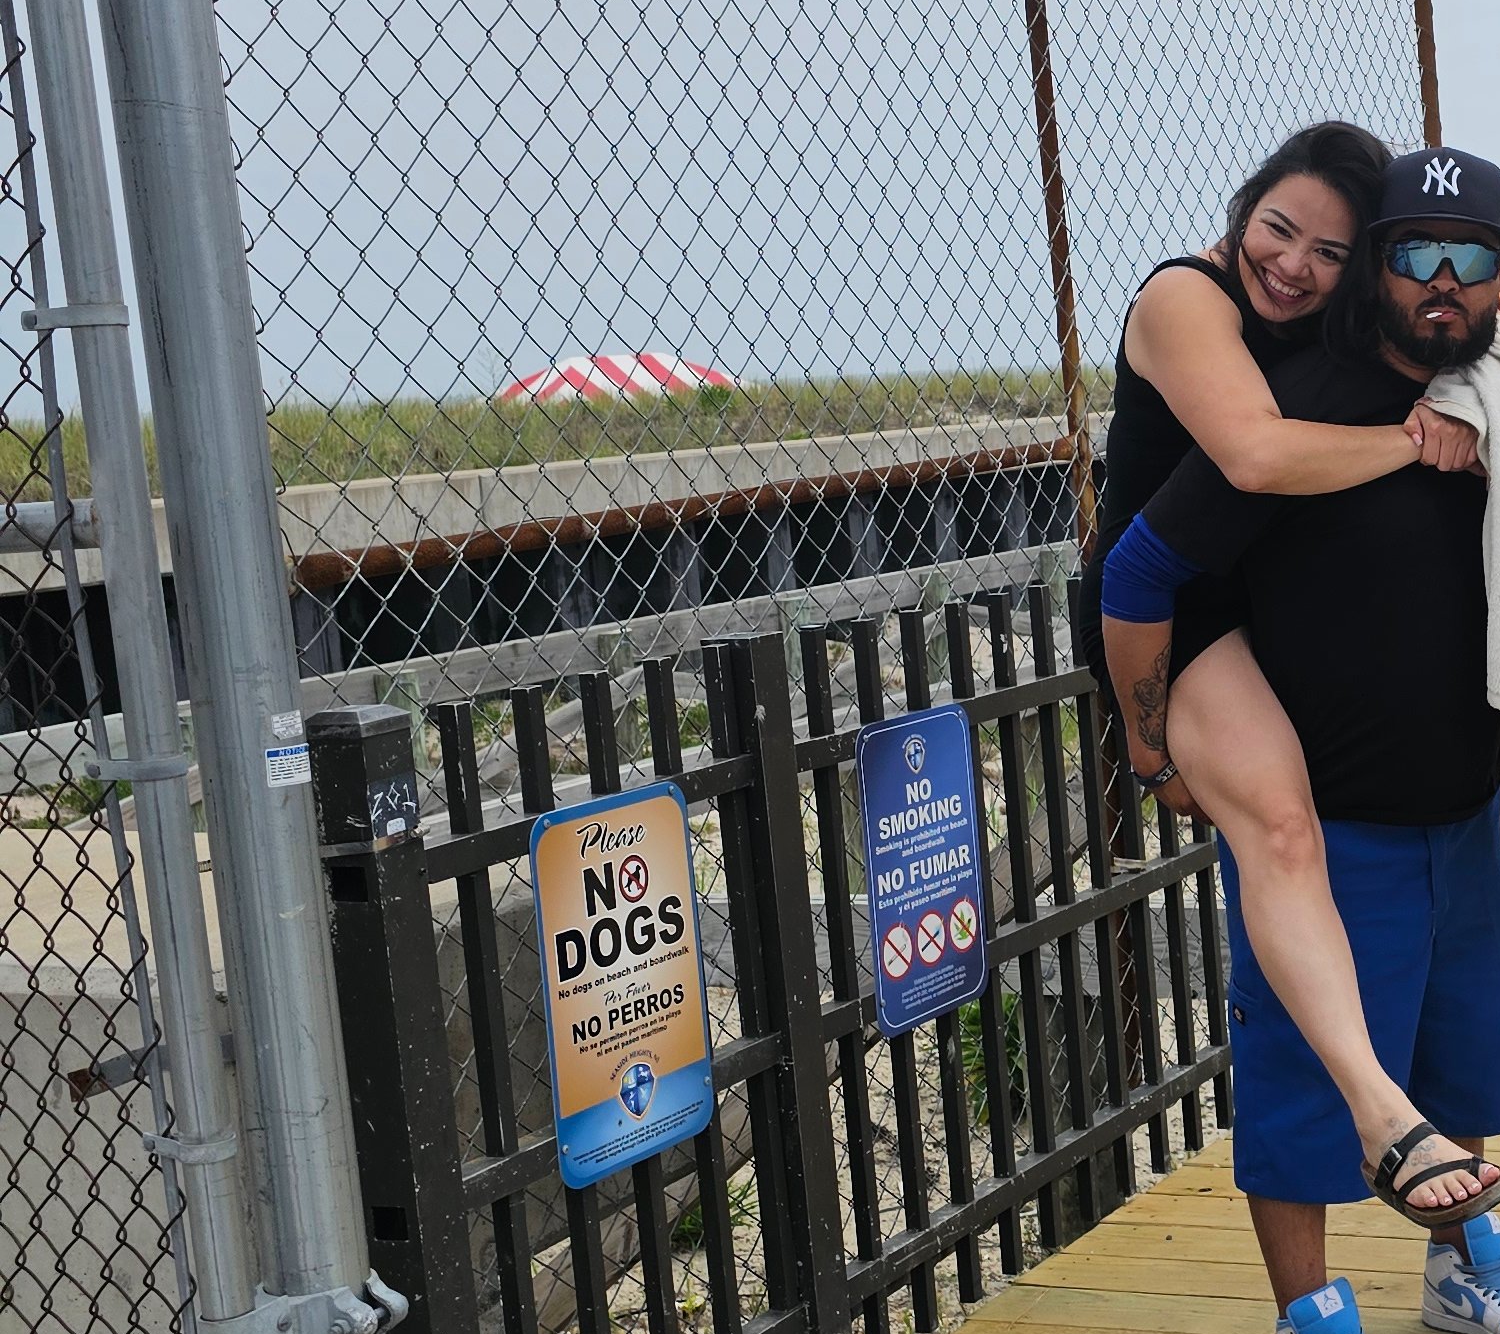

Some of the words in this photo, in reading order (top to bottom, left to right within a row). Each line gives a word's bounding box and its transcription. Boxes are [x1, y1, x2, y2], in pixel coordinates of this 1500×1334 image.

[1421, 156, 1462, 196] NY
[905, 778, 932, 806] NO
[878, 794, 962, 840] SMOKING
[576, 822, 646, 859] Please
[875, 840, 903, 855] Smoking
[903, 837, 910, 845] is
[910, 826, 941, 845] prohibited
[901, 846, 914, 857] and
[914, 836, 946, 853] boardwalk
[877, 867, 904, 897] NO
[909, 844, 971, 885] FUMAR
[893, 886, 923, 905] prohibido
[923, 880, 941, 892] fumar
[941, 877, 949, 885] en
[950, 874, 957, 882] la
[957, 868, 973, 881] playa
[898, 905, 903, 915] y
[903, 901, 911, 910] el
[911, 896, 930, 910] paseo
[555, 895, 685, 983] DOGS
[558, 990, 571, 1000] No
[572, 982, 593, 995] dogs
[594, 977, 605, 987] on
[606, 967, 632, 982] beach
[633, 960, 648, 973] and
[649, 946, 690, 967] boardwalk
[571, 1015, 602, 1044] NO
[608, 983, 684, 1030] PERROS
[579, 1045, 589, 1054] No
[590, 1042, 598, 1050] se
[599, 1030, 628, 1047] permiten
[628, 1022, 649, 1036] perros
[649, 1018, 658, 1026] en
[658, 1014, 665, 1022] la
[665, 1009, 682, 1021] playa
[613, 1043, 620, 1051] el
[621, 1036, 640, 1049] paseo
